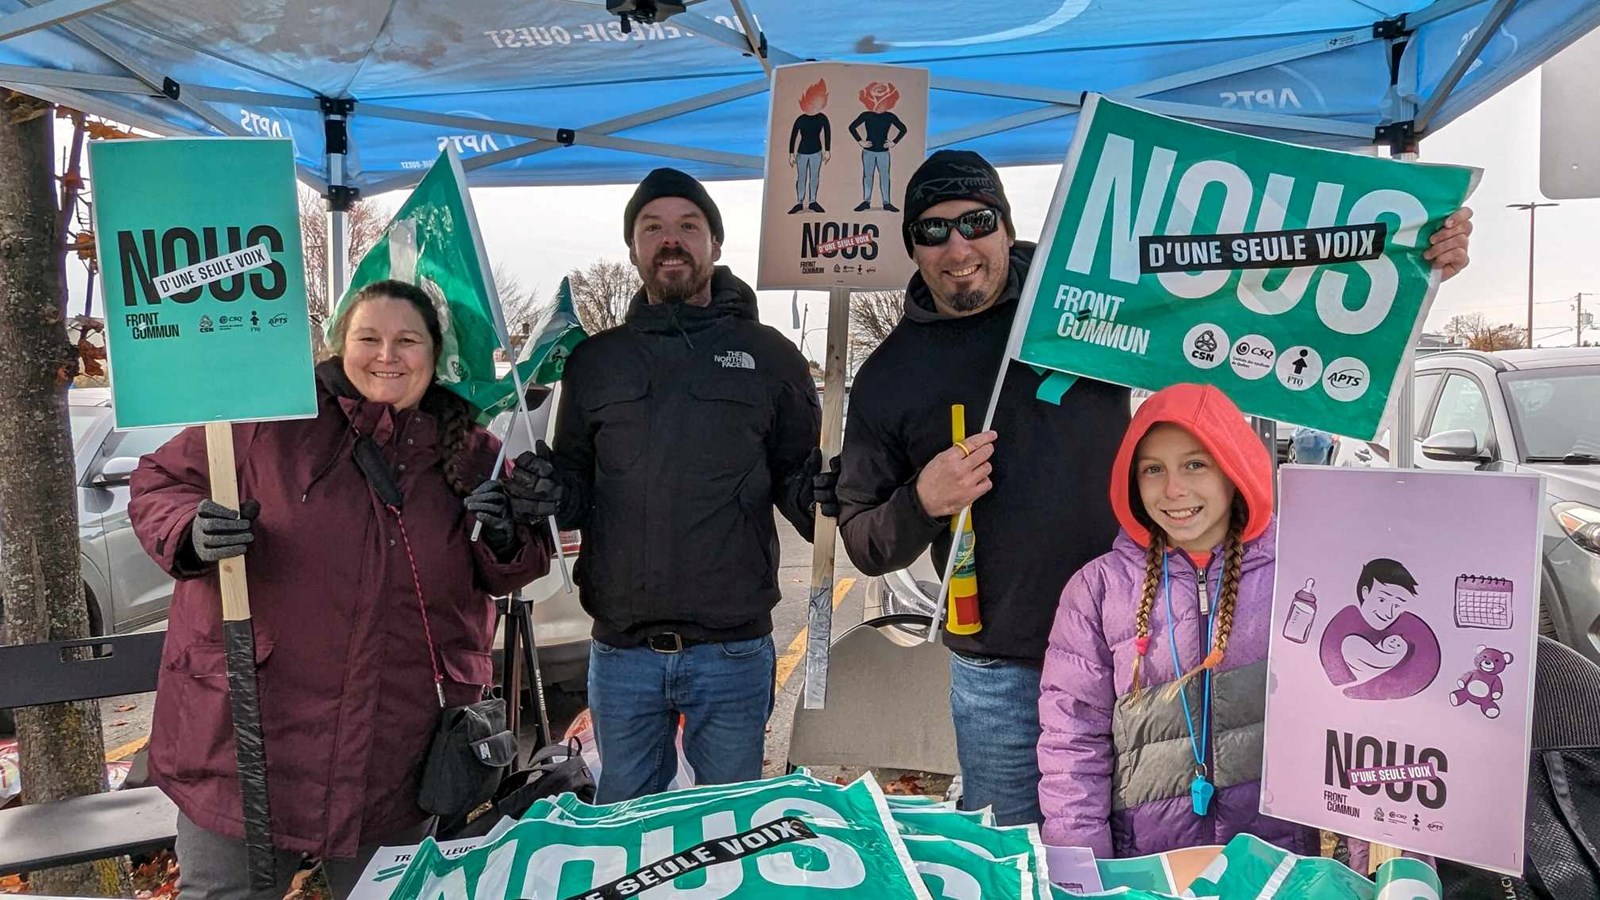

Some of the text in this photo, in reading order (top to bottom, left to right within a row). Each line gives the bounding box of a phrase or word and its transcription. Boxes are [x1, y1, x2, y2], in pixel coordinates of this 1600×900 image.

[801, 222, 879, 260] NOUS
[837, 238, 855, 249] SEULE
[855, 234, 869, 244] VOIX
[1065, 132, 1428, 335] NOUS
[1150, 229, 1376, 268] D'UNE SEULE VOIX
[117, 225, 287, 306] NOUS
[159, 248, 266, 293] D'UNE SEULE VOIX
[1053, 285, 1124, 323] FRONT
[125, 312, 159, 327] FRONT
[132, 323, 180, 340] COMMUN
[1057, 312, 1150, 355] COMMUN
[714, 354, 742, 363] NORTH
[1192, 350, 1214, 362] CSN
[1251, 347, 1274, 359] CSQ
[1287, 376, 1304, 387] FTQ
[1327, 372, 1362, 386] APTS
[1324, 728, 1448, 809] NOUS
[1350, 765, 1432, 783] D'UNE SEULE VOIX
[1323, 790, 1348, 805] FRONT
[1327, 800, 1360, 818] COMMUN
[615, 820, 802, 896] SEULE VOIX
